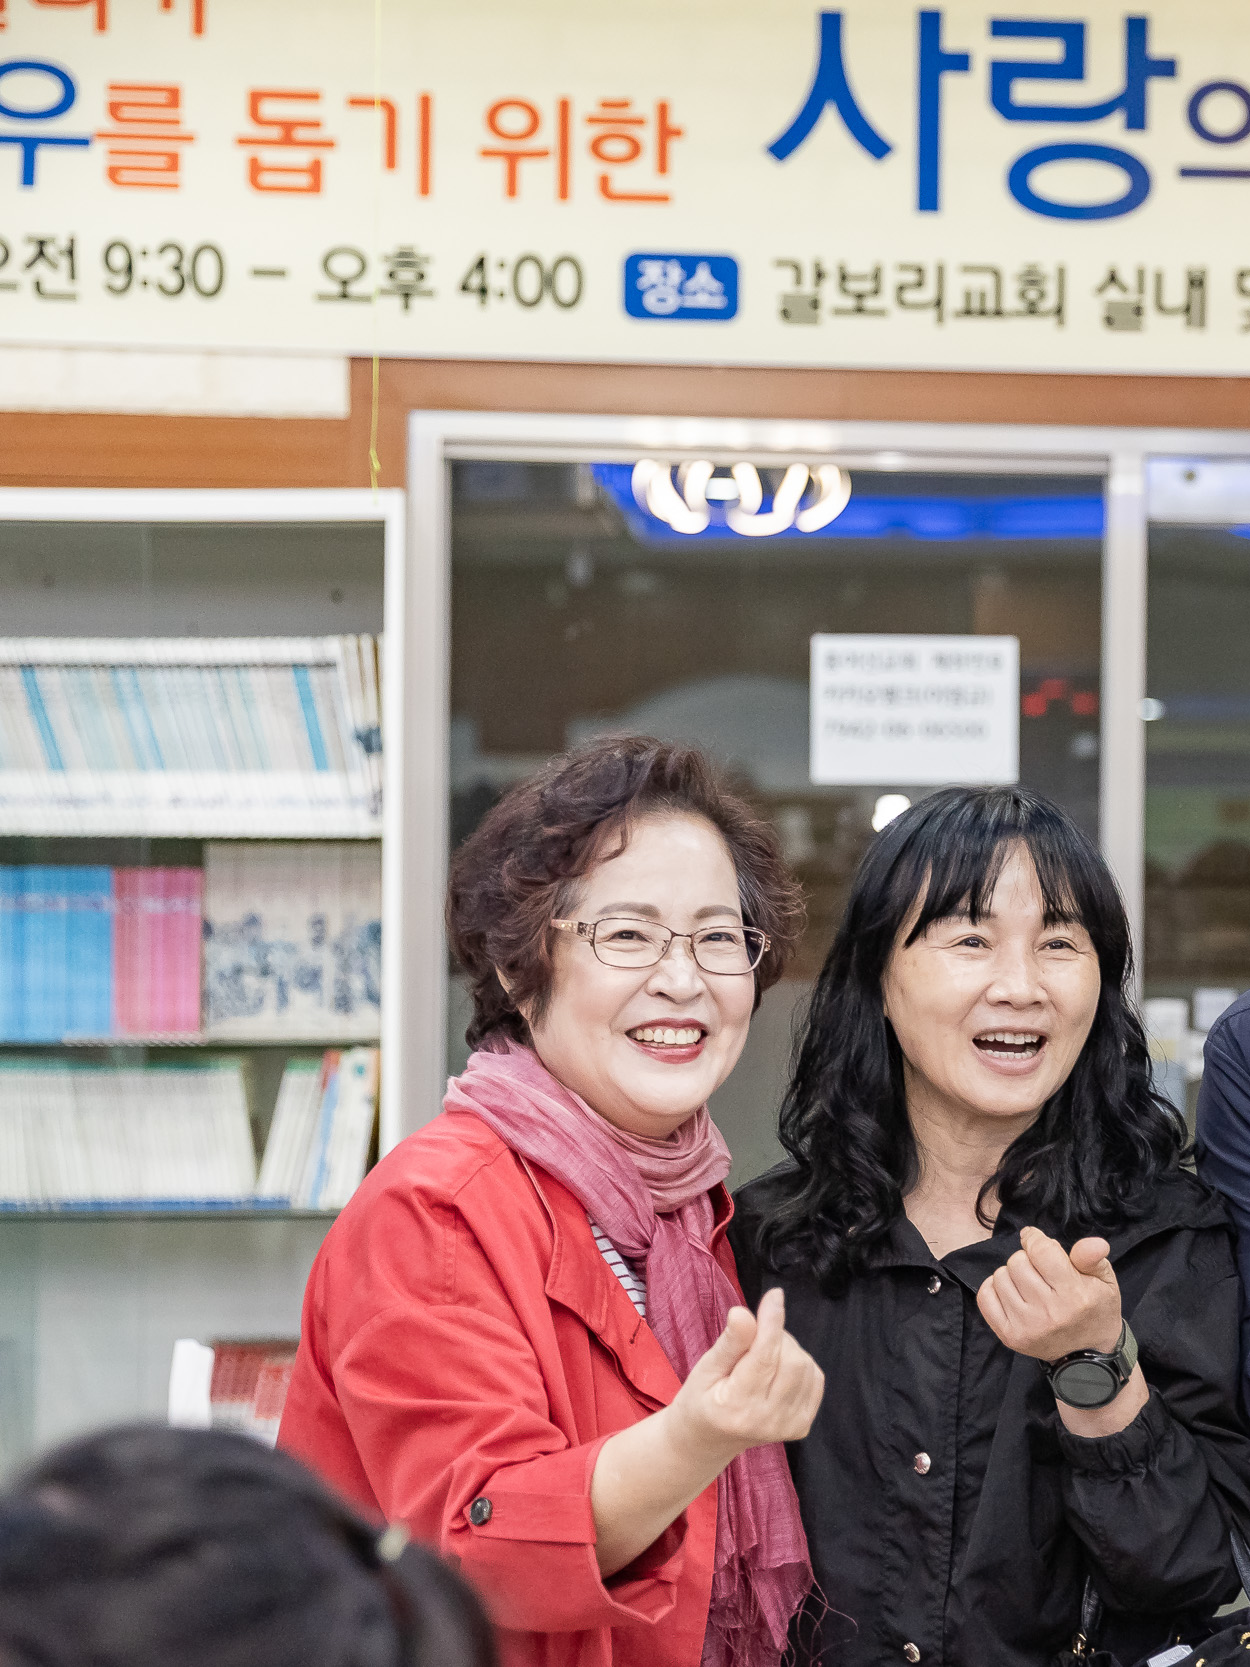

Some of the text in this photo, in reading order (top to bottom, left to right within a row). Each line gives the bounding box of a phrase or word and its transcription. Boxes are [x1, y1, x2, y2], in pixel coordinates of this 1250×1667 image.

[235, 88, 433, 197] 돕기
[478, 97, 685, 203] 위한
[102, 241, 225, 299] 9:30
[316, 246, 434, 312] 오후
[459, 254, 584, 310] 4:00
[636, 259, 729, 315] 장소
[775, 258, 1067, 328] 갈보리교회
[1096, 267, 1208, 332] 실내
